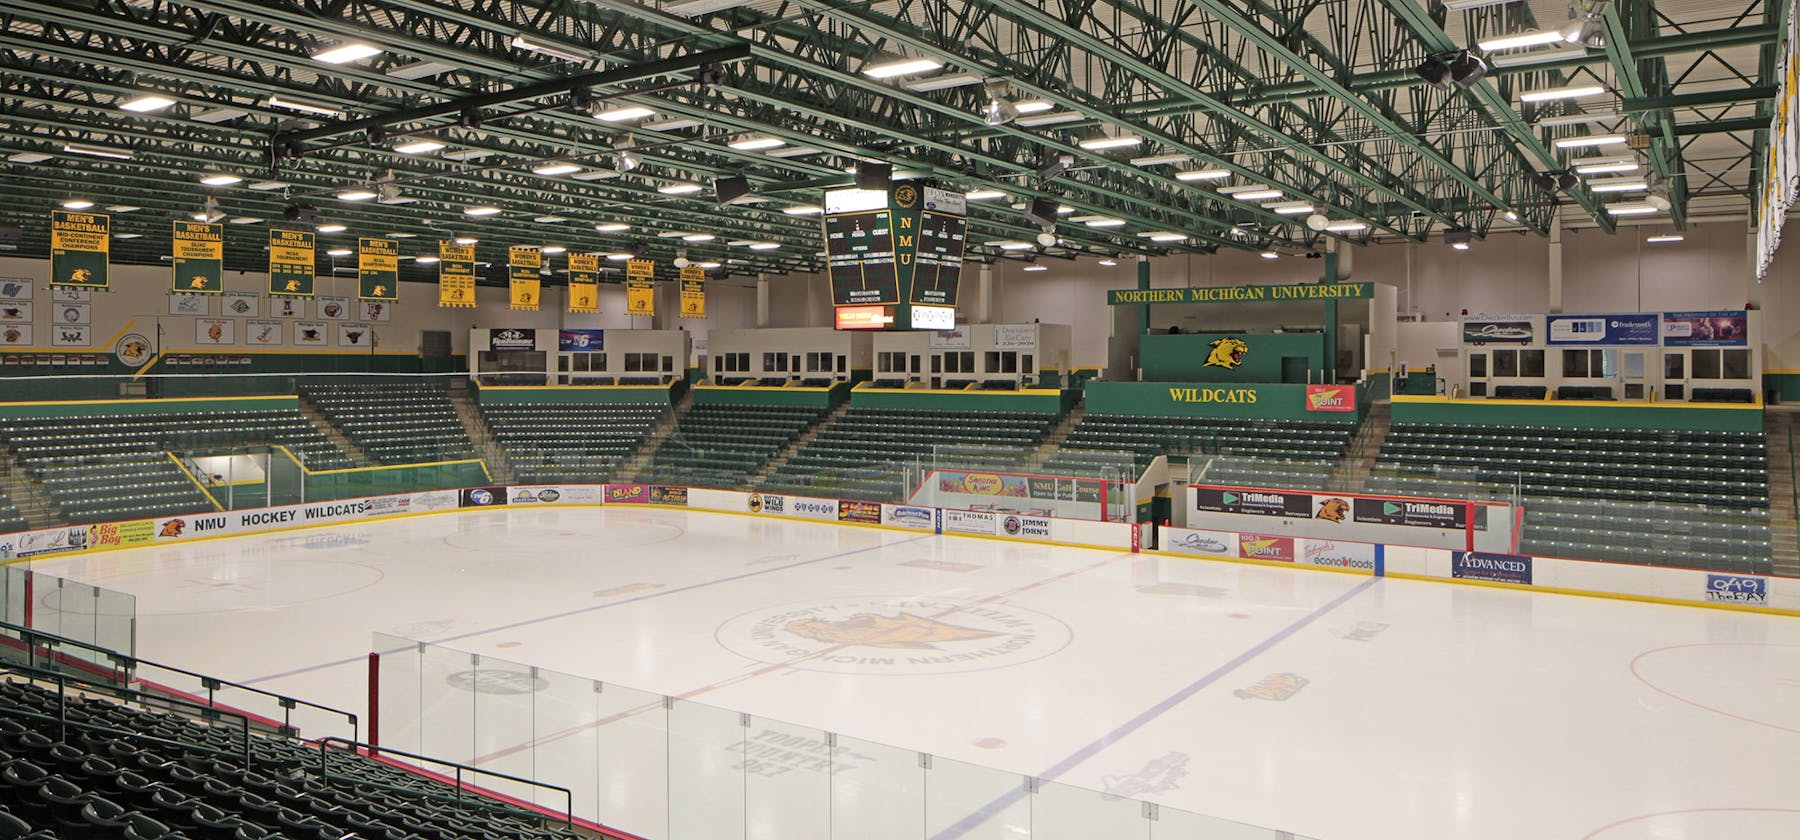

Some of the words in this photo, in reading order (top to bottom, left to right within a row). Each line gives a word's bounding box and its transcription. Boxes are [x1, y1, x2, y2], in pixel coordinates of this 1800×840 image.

[66, 214, 94, 224] MEN'S
[54, 222, 108, 232] BASKETBALL
[186, 224, 210, 232] MEN'S
[57, 232, 104, 240] MID-CONTINENT
[176, 230, 220, 240] BASKETBALL
[282, 232, 304, 240] MEN'S
[272, 238, 312, 248] BASKETBALL
[370, 240, 388, 248] MEN'S
[362, 246, 397, 256] BASKETBALL
[1114, 290, 1184, 303] NORTHERN
[1192, 287, 1264, 302] MICHIGAN
[1272, 284, 1364, 299] UNIVERSITY
[1169, 388, 1257, 404] WILDCATS
[1314, 397, 1344, 406] POINT
[1034, 482, 1054, 490] NMU
[764, 499, 784, 507] WILD
[1242, 492, 1284, 504] TriMedia
[1405, 502, 1454, 516] TriMedia
[194, 517, 226, 531] NMU
[241, 510, 296, 526] HOCKEY
[304, 502, 364, 519] WILDCATS
[963, 512, 994, 521] THOMAS
[1022, 519, 1049, 527] JIMMY
[100, 524, 118, 536] Big
[1022, 528, 1049, 536] JOHN'S
[101, 534, 122, 546] Boy
[1248, 546, 1281, 556] POINT
[1460, 552, 1526, 572] ADVANCED
